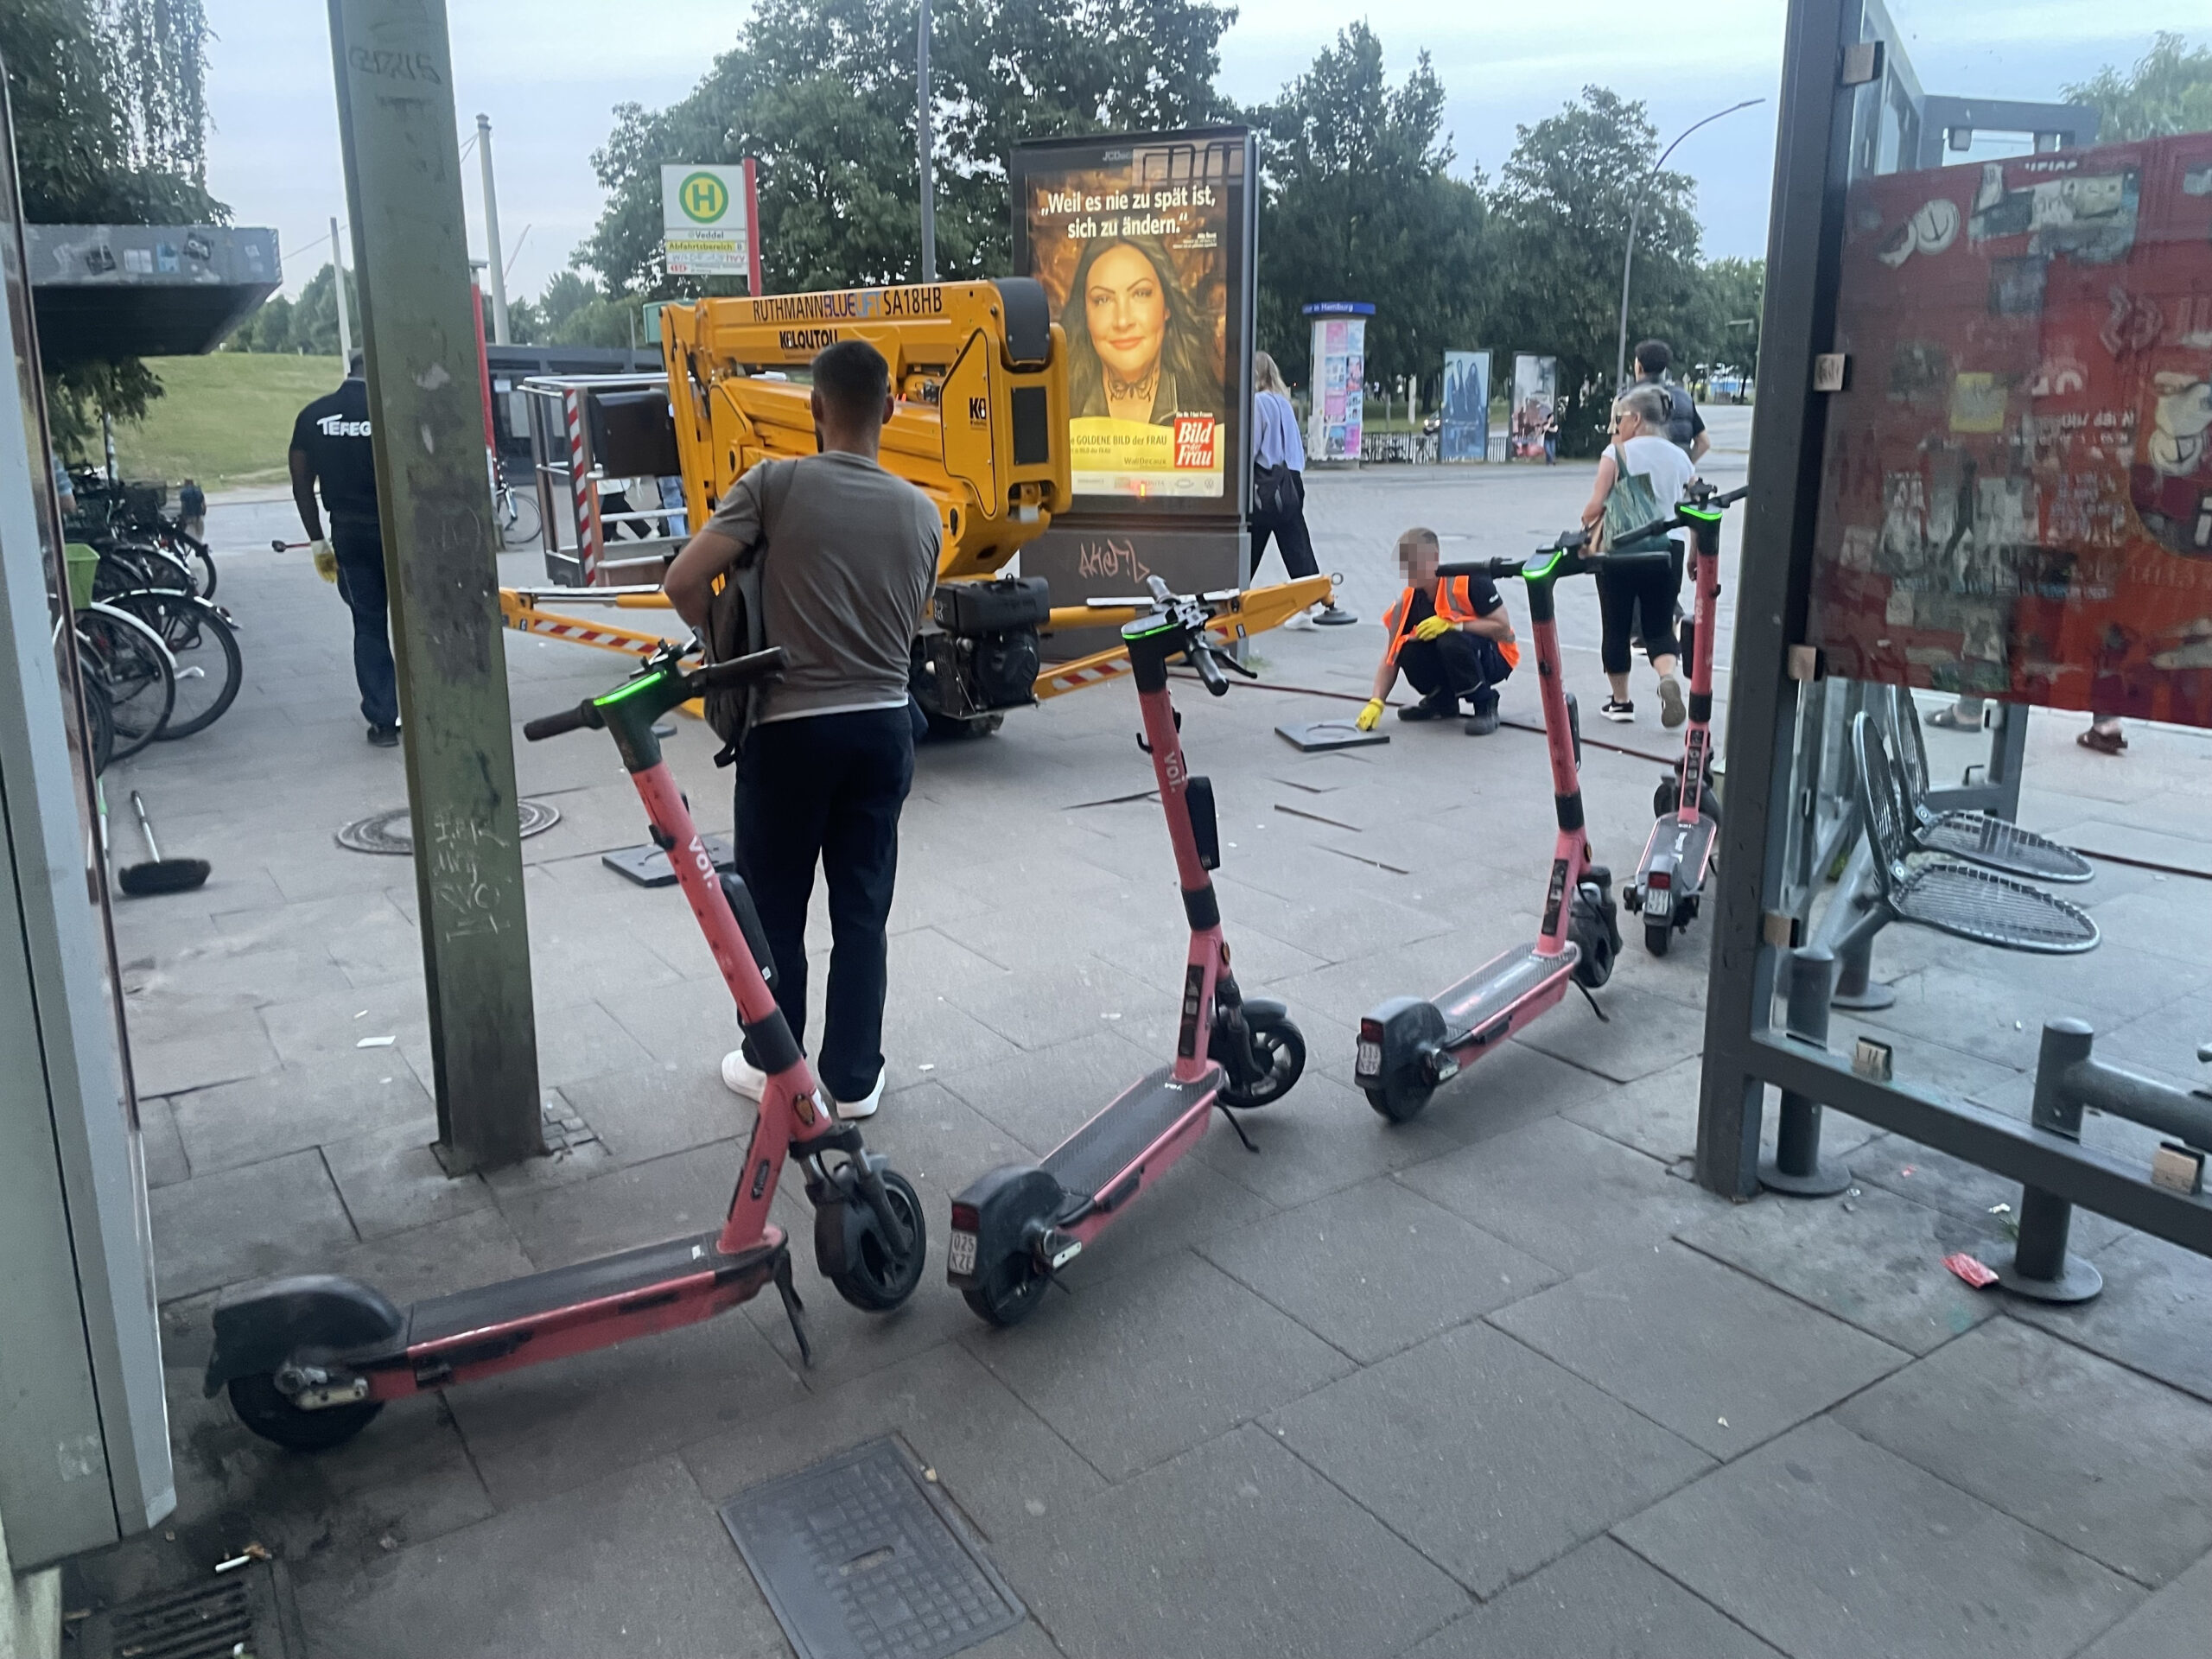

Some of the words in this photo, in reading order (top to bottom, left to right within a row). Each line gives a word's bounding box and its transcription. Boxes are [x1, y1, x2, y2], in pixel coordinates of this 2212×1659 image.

[692, 184, 715, 212] H
[1085, 196, 1102, 211] es
[1105, 189, 1128, 211] nie
[1132, 194, 1150, 209] zu
[1154, 187, 1188, 210] spät
[1192, 185, 1216, 207] ist,
[1068, 218, 1096, 239] sich
[1101, 222, 1118, 237] zu
[669, 243, 733, 251] Abfahrtsbereich
[883, 287, 942, 315] SA18HB
[1321, 302, 1353, 312] Hamburg
[1077, 435, 1111, 446] GOLDENE
[1113, 435, 1130, 446] BILD
[1133, 435, 1145, 446] der
[1147, 435, 1167, 446] FRAU
[1177, 422, 1213, 443] Bild
[1177, 444, 1212, 466] Frau
